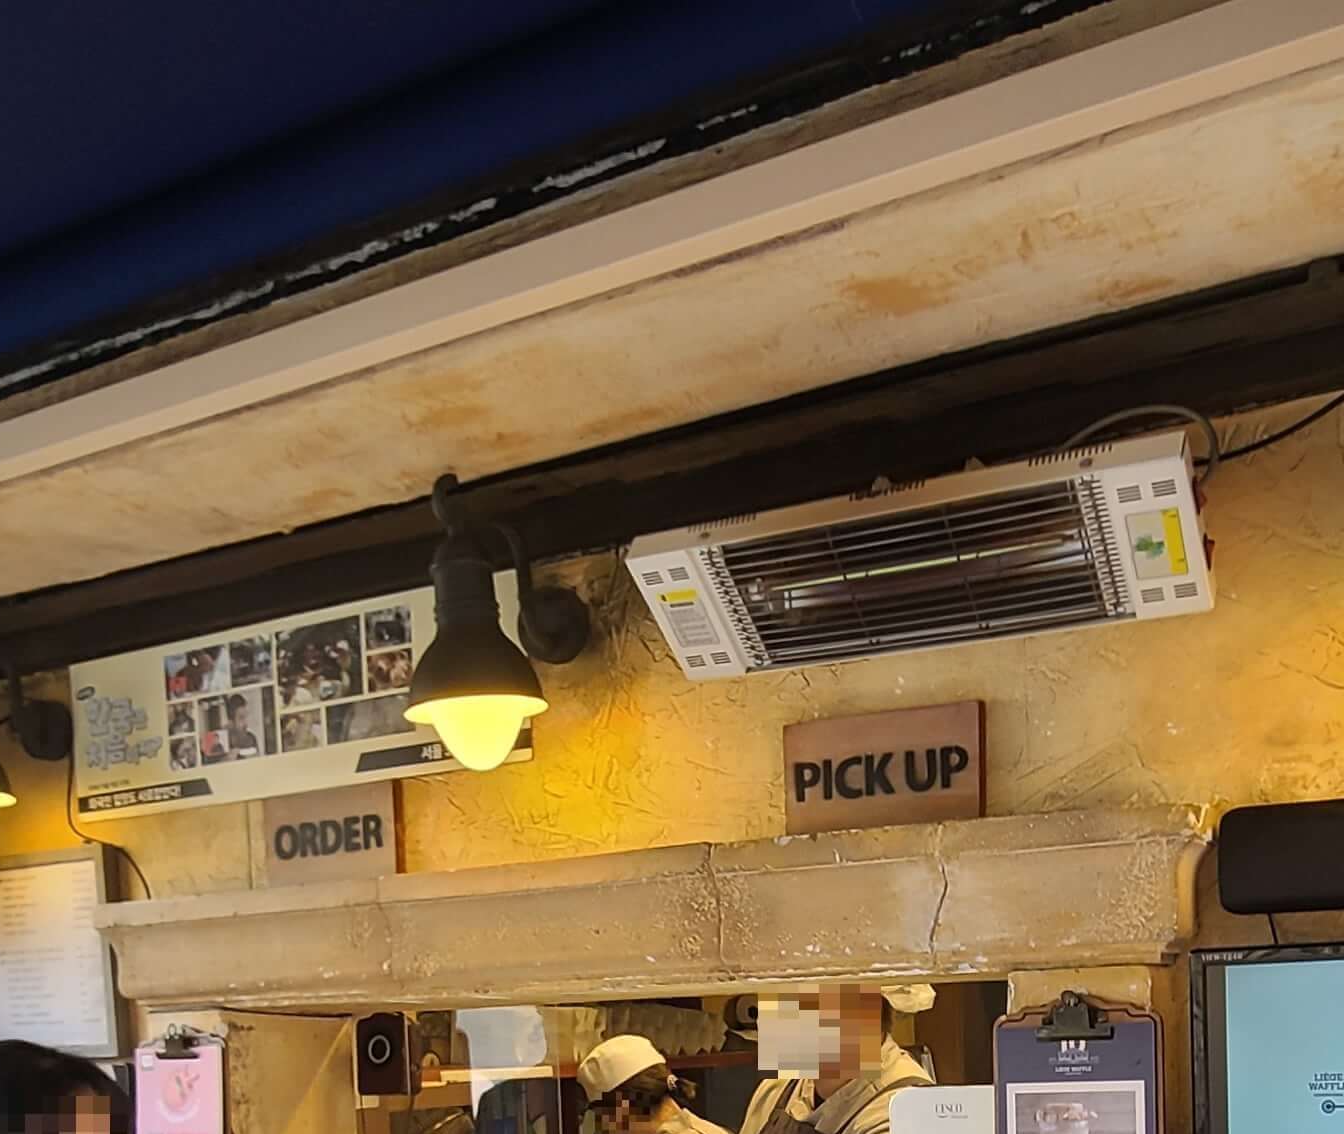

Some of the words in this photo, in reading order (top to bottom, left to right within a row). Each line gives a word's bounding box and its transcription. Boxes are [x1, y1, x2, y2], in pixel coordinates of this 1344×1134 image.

[793, 751, 896, 802] PICK
[903, 745, 969, 791] UP
[274, 814, 384, 861] ORDER
